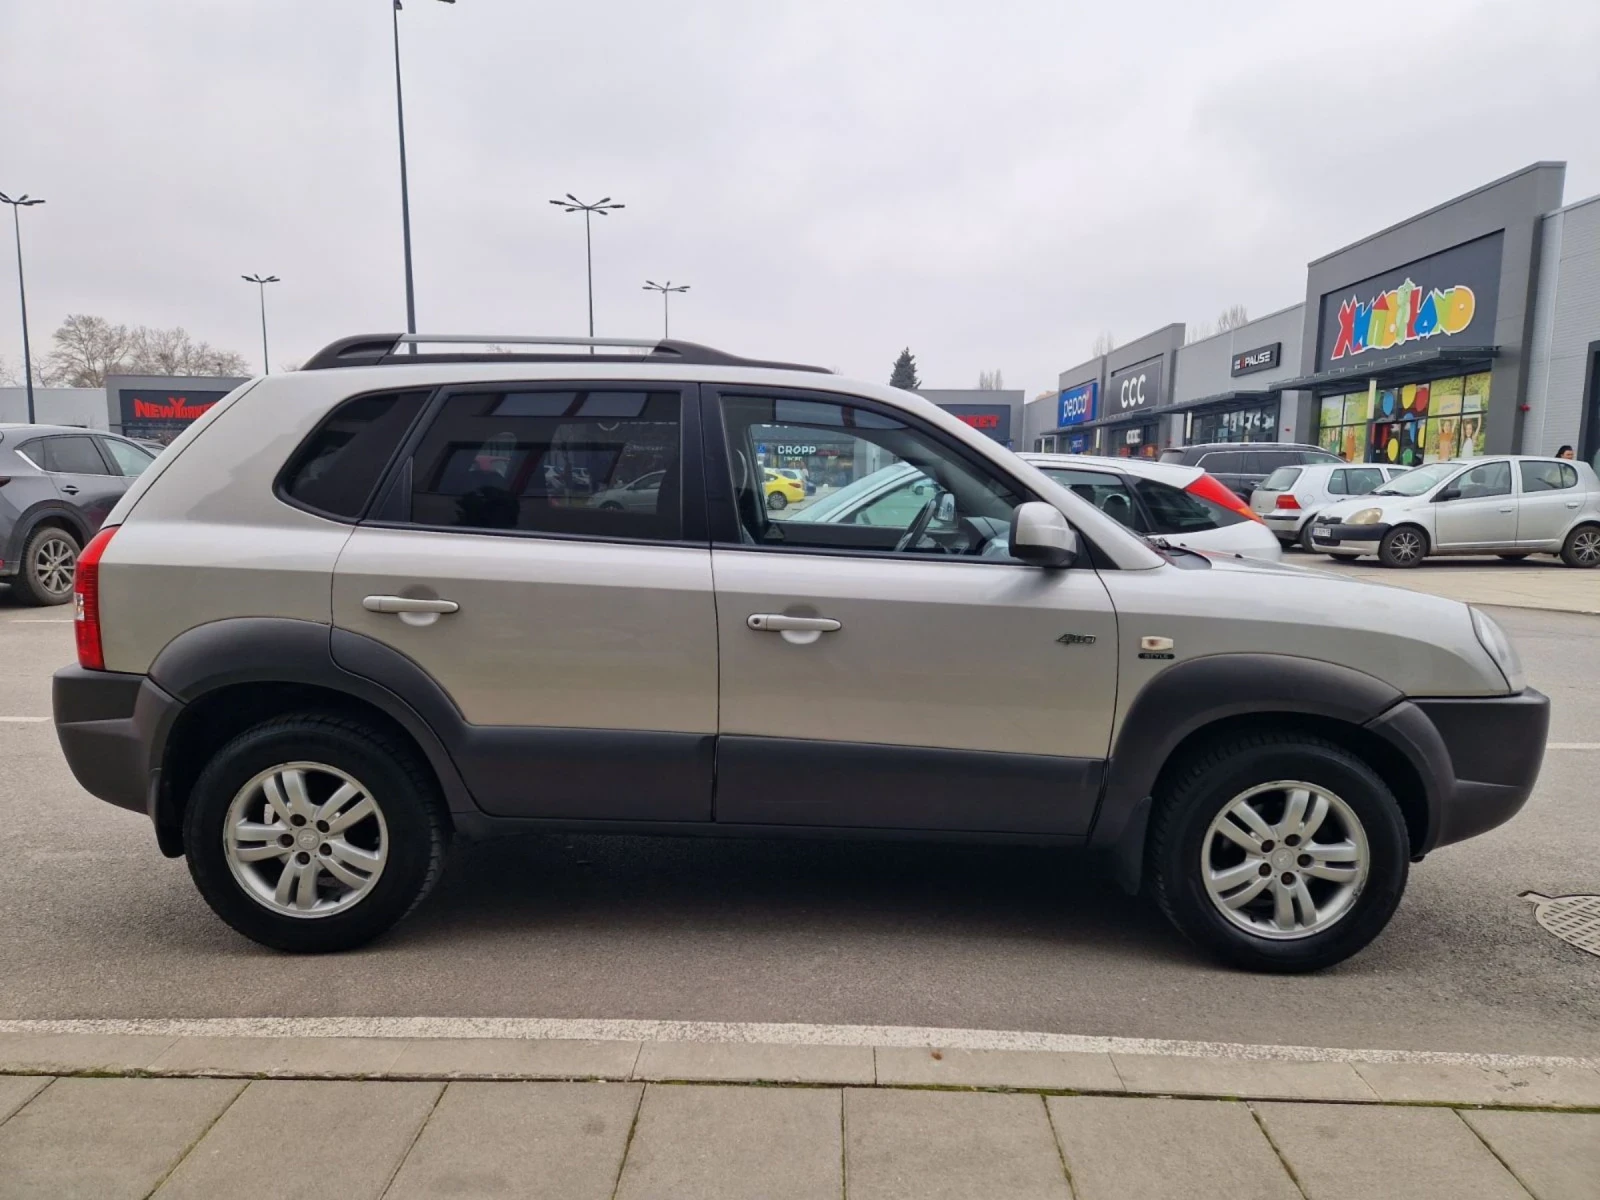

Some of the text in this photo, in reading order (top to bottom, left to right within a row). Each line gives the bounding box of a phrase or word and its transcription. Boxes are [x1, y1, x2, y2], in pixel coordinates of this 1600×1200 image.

[1244, 351, 1271, 368] PAUSE
[1121, 374, 1146, 408] CCC
[1063, 392, 1087, 422] pepco
[777, 445, 816, 455] CROPP
